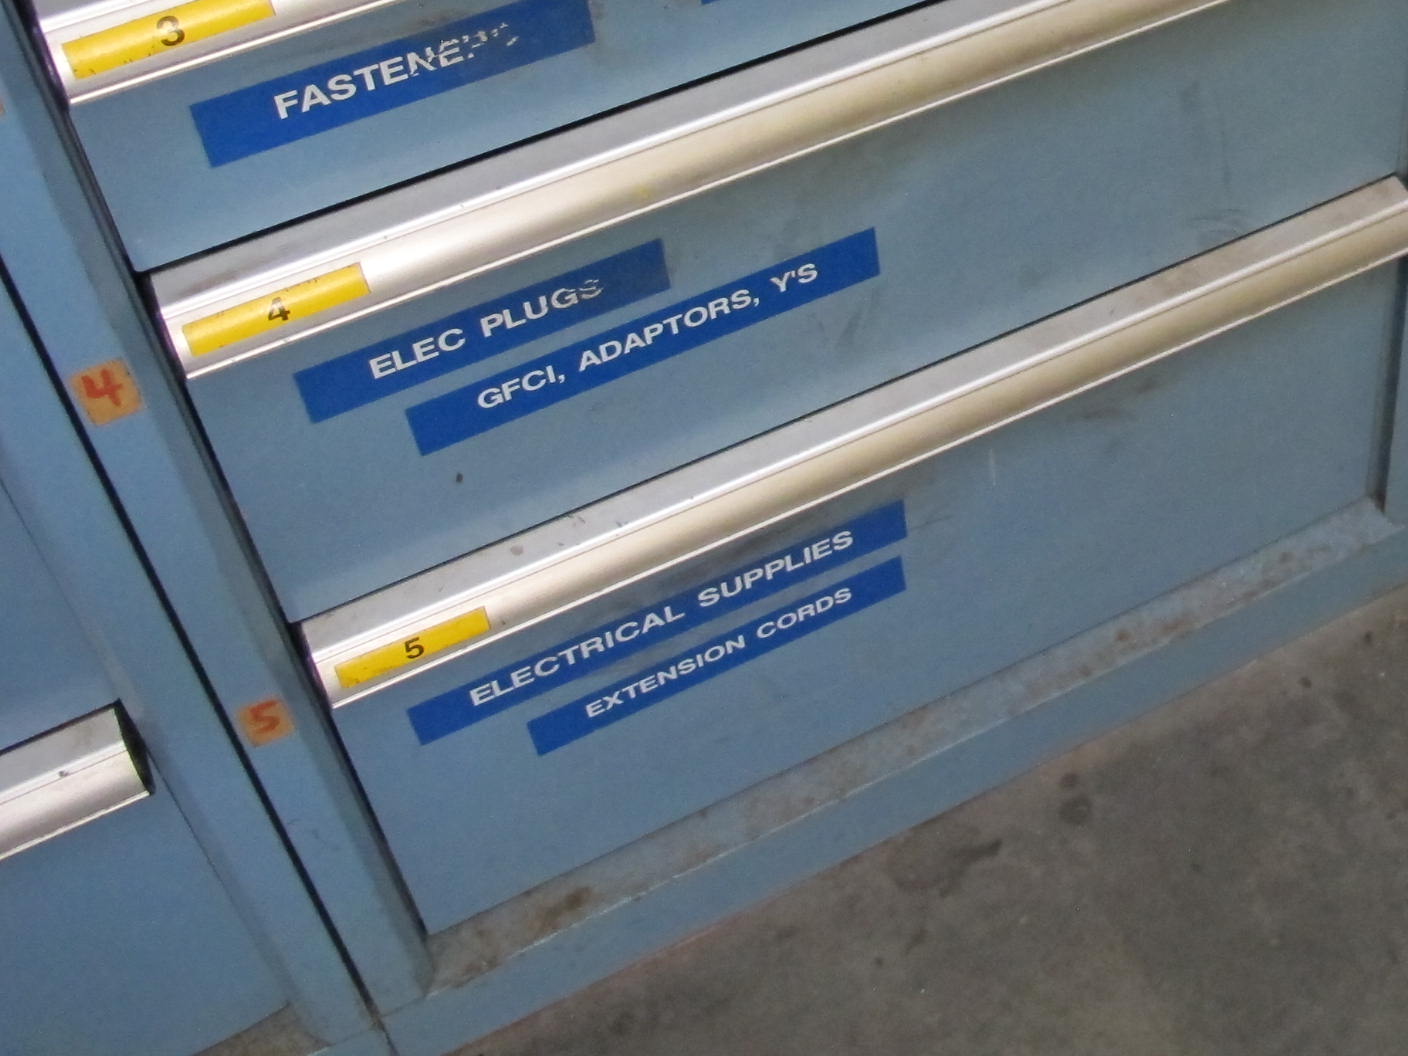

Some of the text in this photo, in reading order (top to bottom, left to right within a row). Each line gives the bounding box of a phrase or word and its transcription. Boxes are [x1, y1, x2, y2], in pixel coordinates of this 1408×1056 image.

[156, 14, 186, 46] 3
[266, 297, 291, 325] 4
[369, 278, 604, 380] ELEC PLUGS
[478, 262, 819, 410] GFCI, ADAPTORS, Y'S
[80, 365, 123, 408] 4
[469, 530, 854, 707] ELECTRICAL SUPPLIES
[403, 636, 426, 661] 5
[585, 586, 853, 718] EXTENSION CORDS
[247, 701, 281, 733] 5
